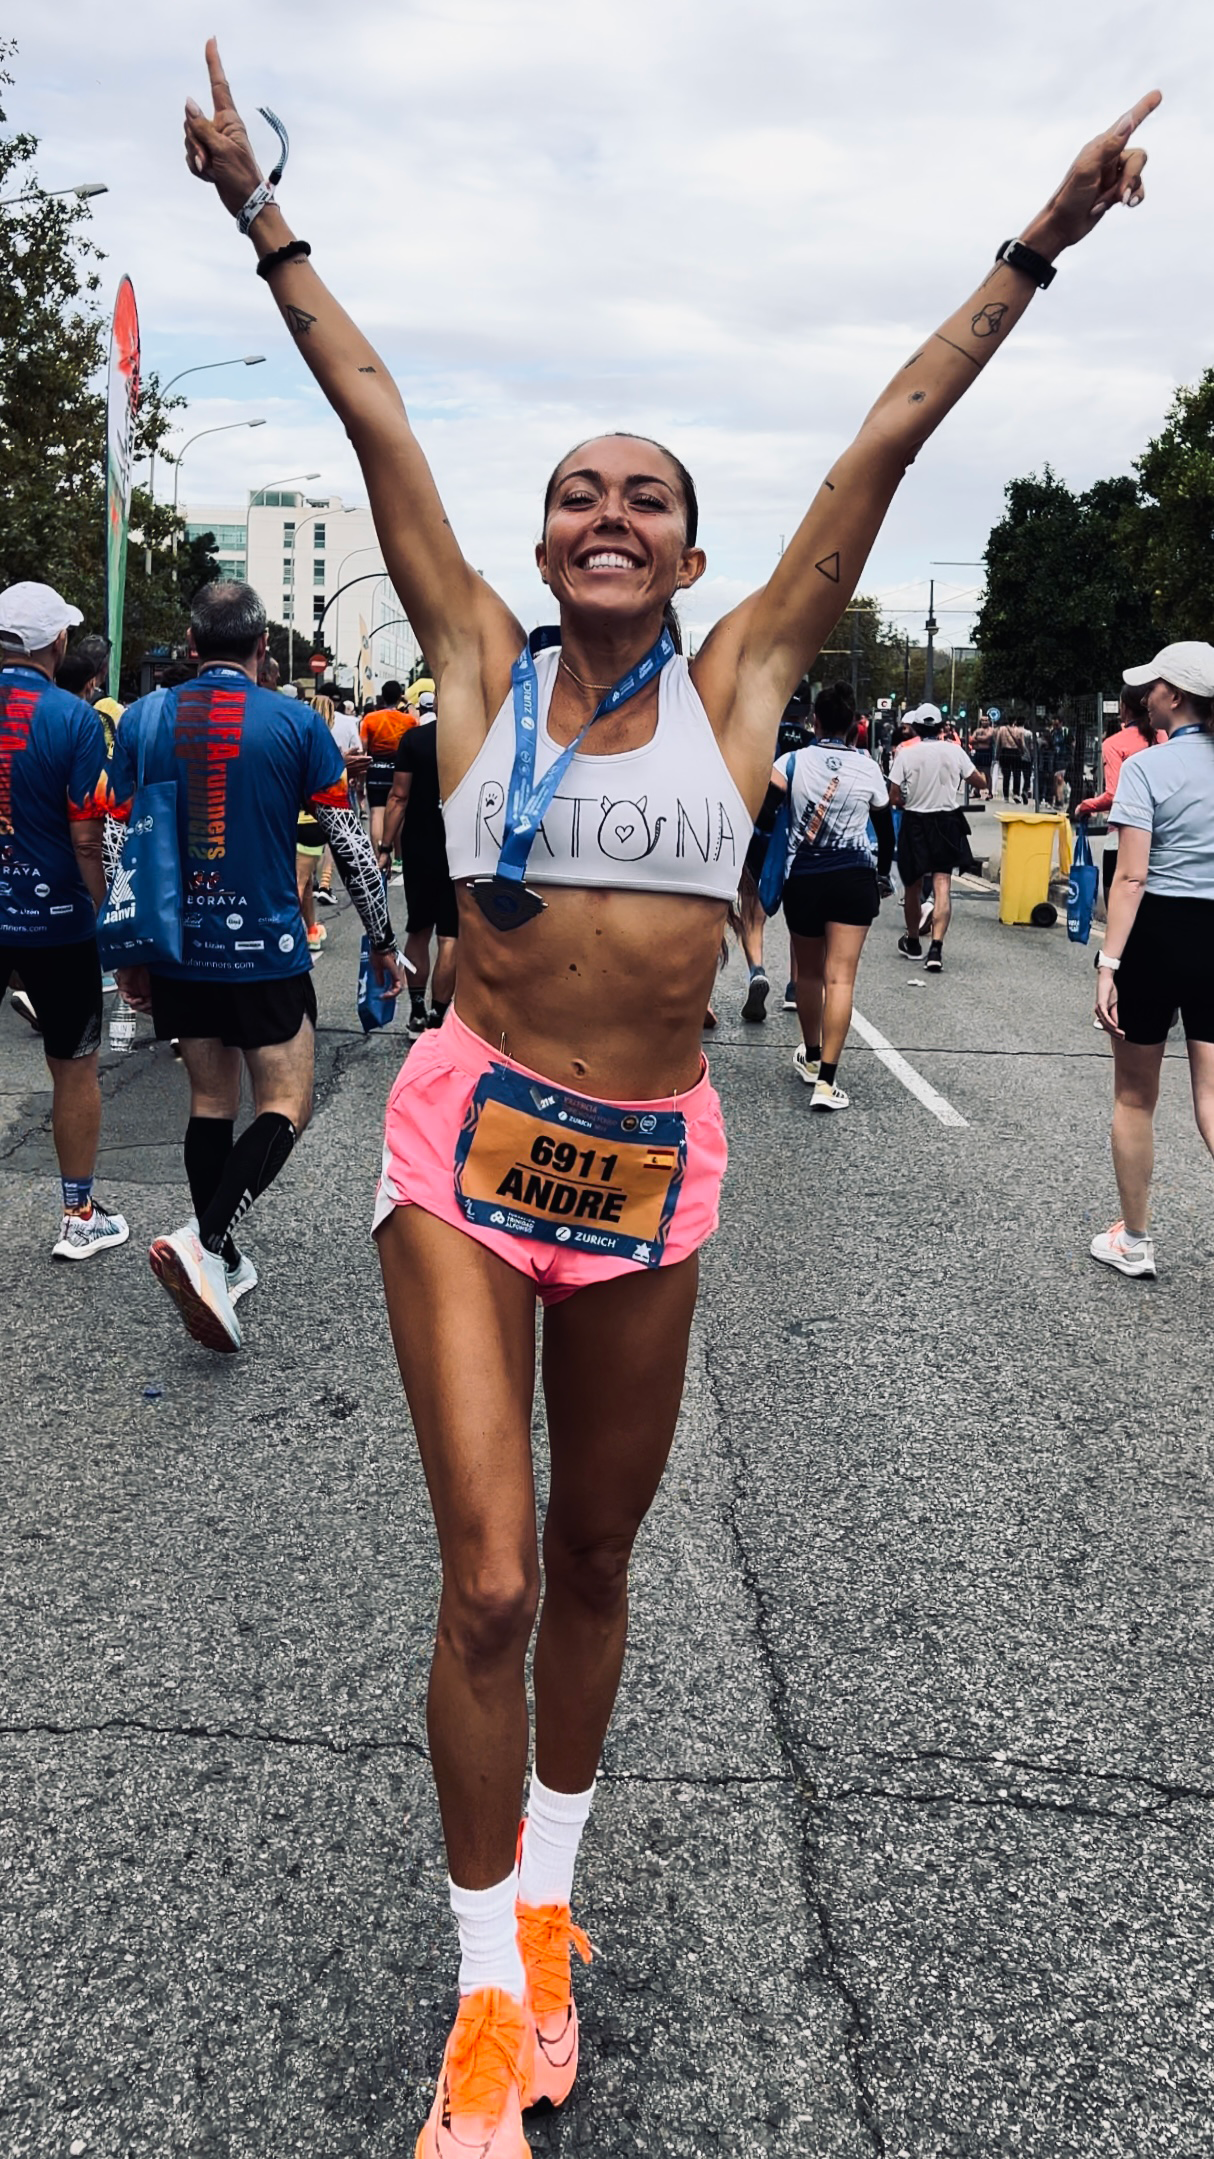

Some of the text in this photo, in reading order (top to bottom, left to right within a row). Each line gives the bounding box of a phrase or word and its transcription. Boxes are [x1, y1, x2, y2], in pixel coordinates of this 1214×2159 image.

[3, 866, 41, 877] RAYA
[187, 895, 248, 906] BORAYA
[568, 1116, 592, 1129] ZURICH
[530, 1135, 618, 1182] 6911
[496, 1167, 627, 1223] ANDRE
[574, 1231, 617, 1248] ZURICH
